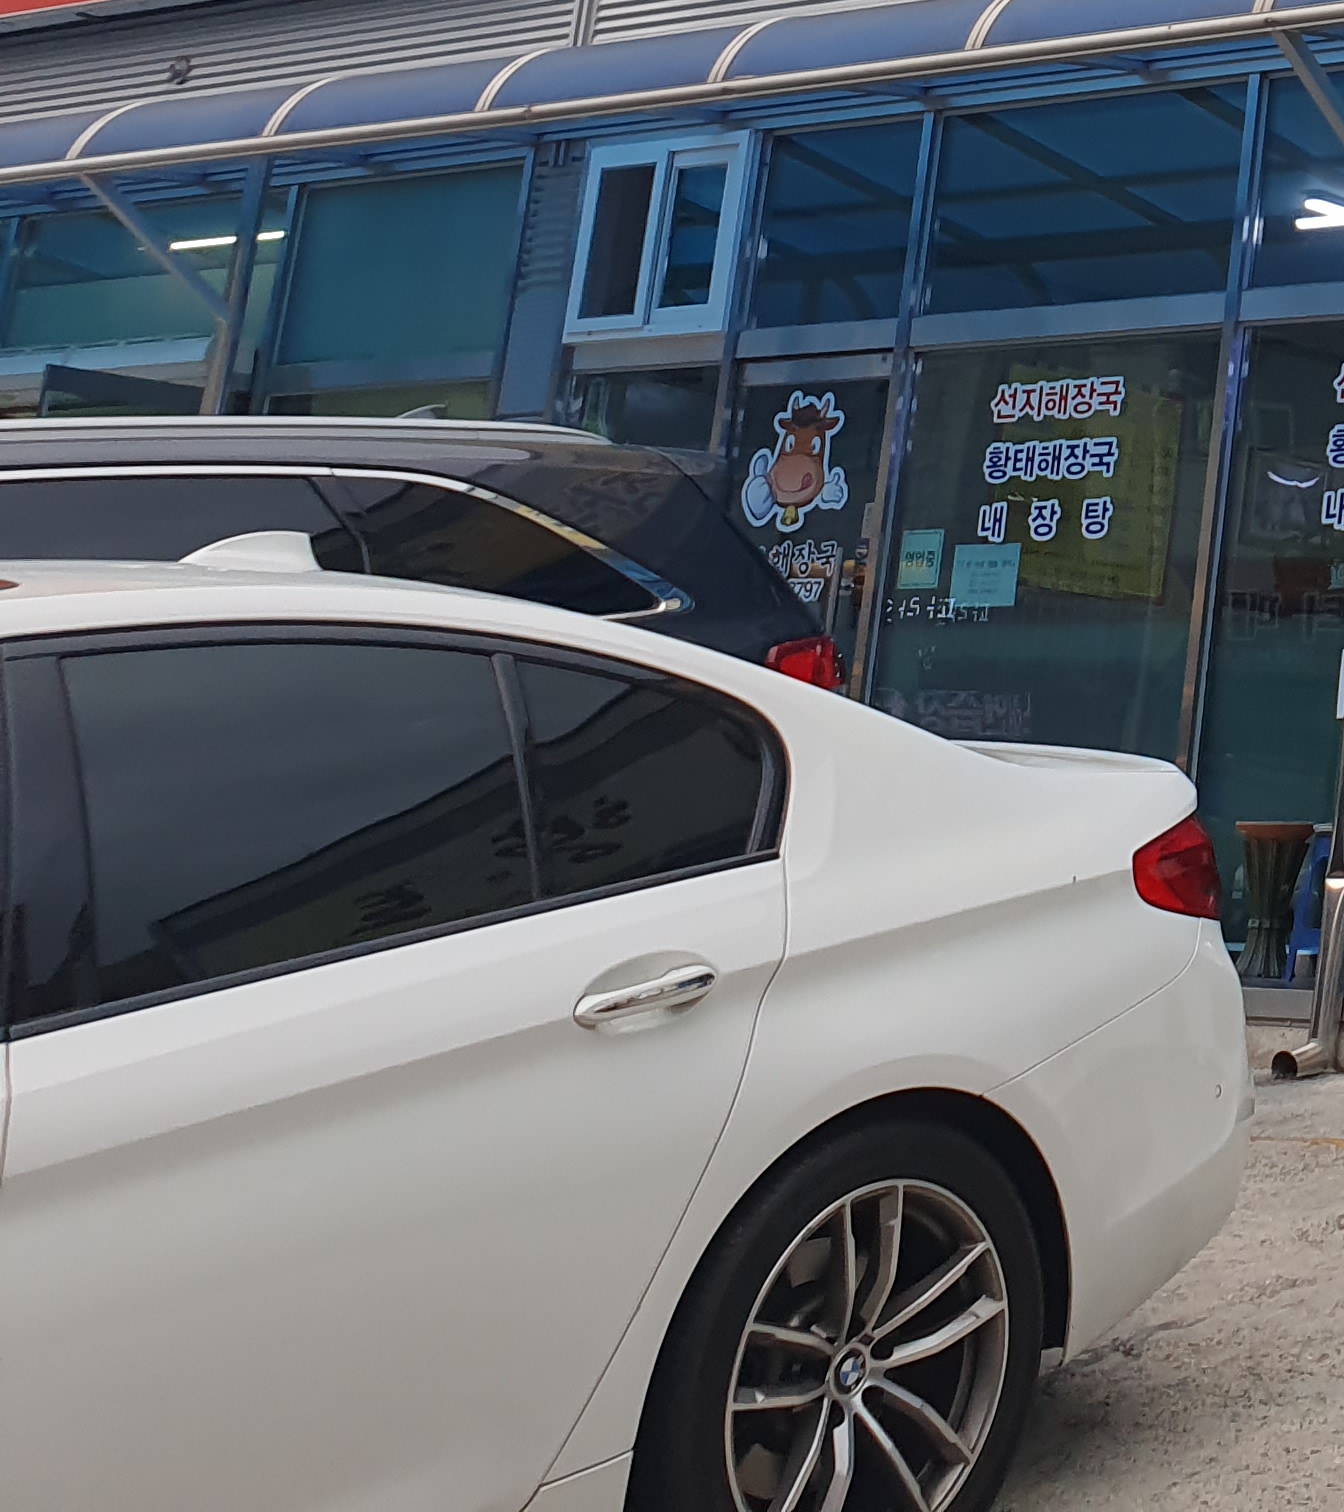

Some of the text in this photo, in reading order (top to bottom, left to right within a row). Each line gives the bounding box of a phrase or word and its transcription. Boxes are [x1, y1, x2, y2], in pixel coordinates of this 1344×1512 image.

[992, 377, 1124, 423] 선지해장국
[985, 438, 1117, 483] 황태해장국
[905, 550, 935, 569] 영업중
[788, 578, 824, 602] 797
